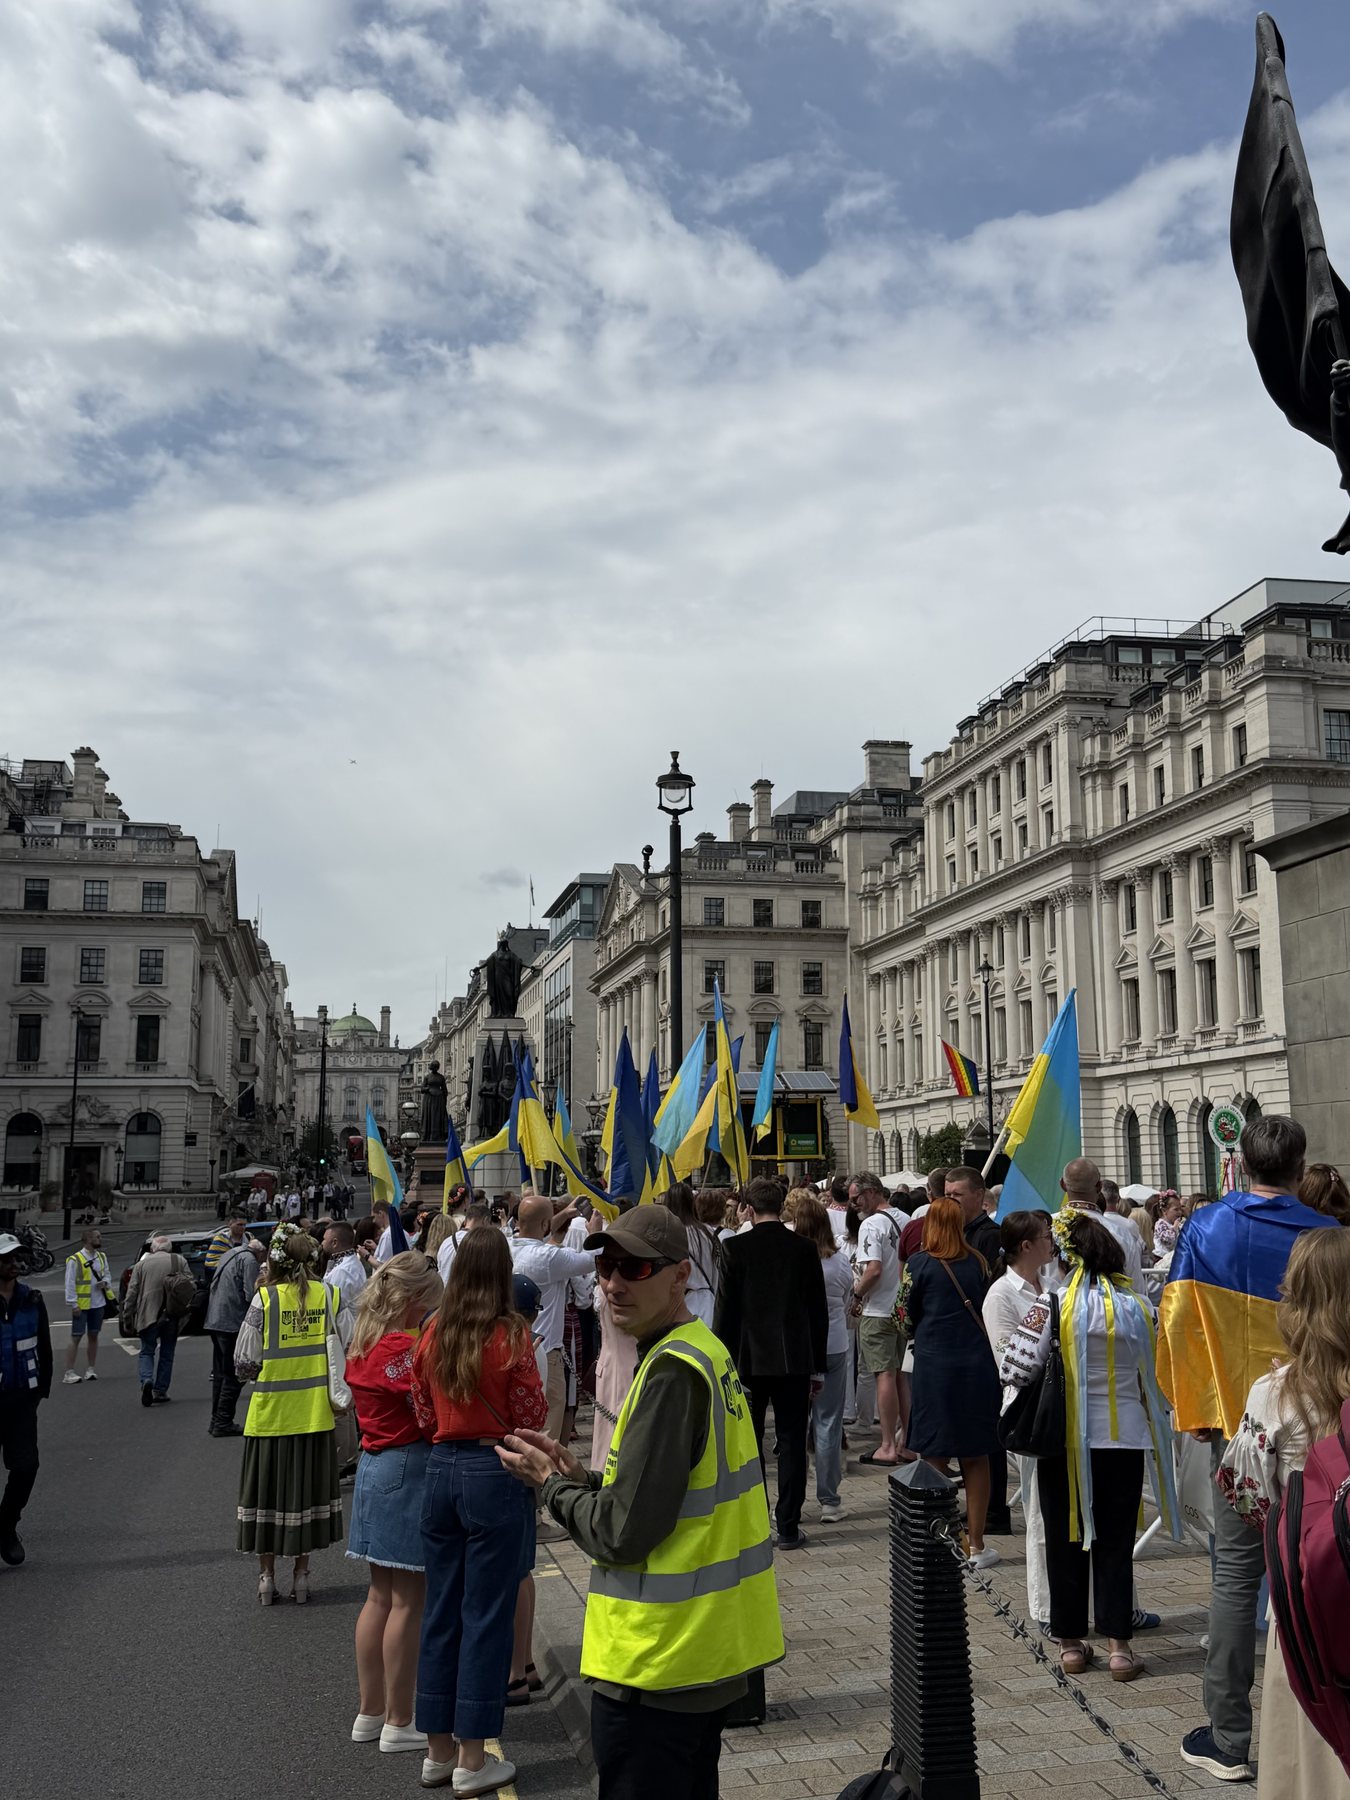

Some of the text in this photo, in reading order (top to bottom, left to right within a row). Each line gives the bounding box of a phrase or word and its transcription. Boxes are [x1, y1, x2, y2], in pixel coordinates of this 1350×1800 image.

[292, 1309, 325, 1317] UAINIAN
[292, 1317, 320, 1325] SORT
[292, 1325, 309, 1333] TAM
[1184, 1504, 1199, 1519] COS
